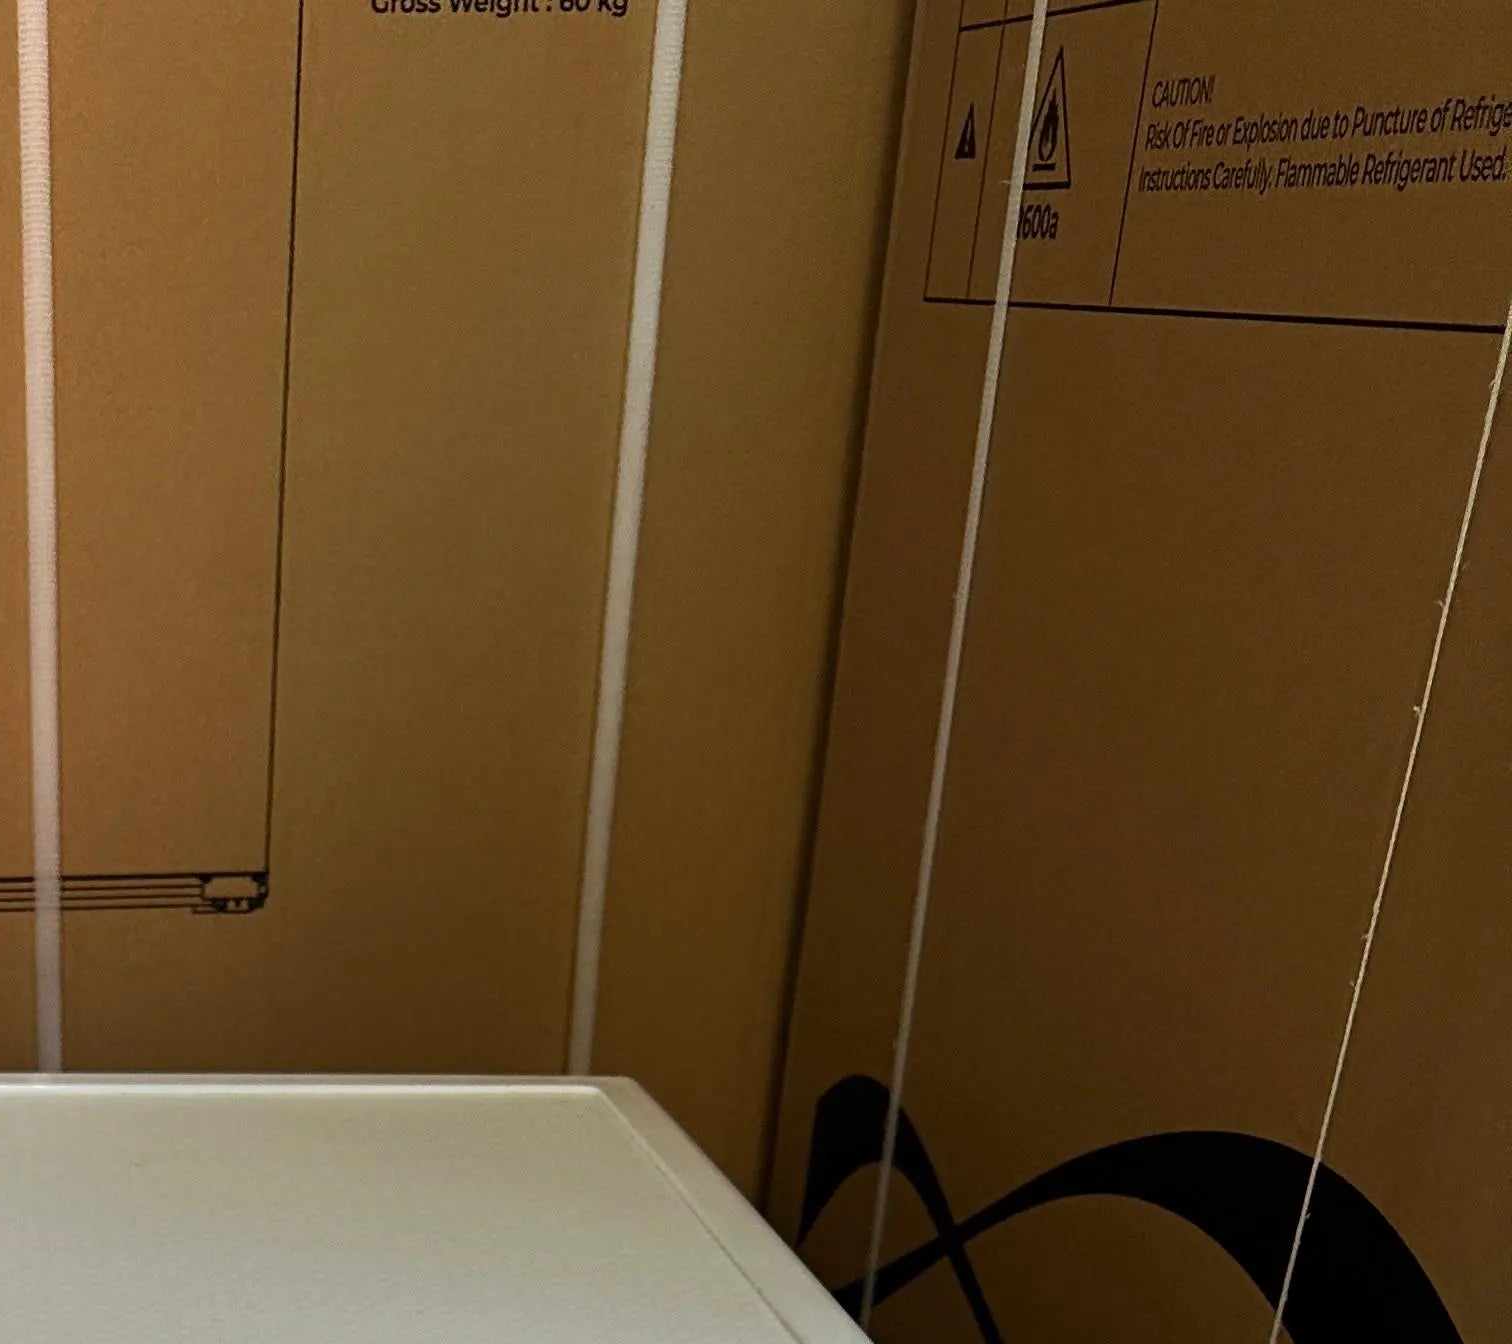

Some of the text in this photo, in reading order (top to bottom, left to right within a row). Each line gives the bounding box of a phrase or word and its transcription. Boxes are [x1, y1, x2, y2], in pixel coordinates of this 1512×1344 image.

[1152, 74, 1216, 108] CAUTION!
[1145, 119, 1172, 150] Risk
[1172, 115, 1191, 146] Of
[1190, 115, 1216, 147] Fire
[1216, 121, 1230, 145] or
[1232, 110, 1300, 149] Explosion
[1301, 107, 1330, 143] due
[1331, 107, 1348, 139] to
[1351, 100, 1428, 139] Puncture
[1430, 96, 1451, 132] of
[1138, 145, 1508, 196] Instructions Carefully. Flammable Refrigerant Used.
